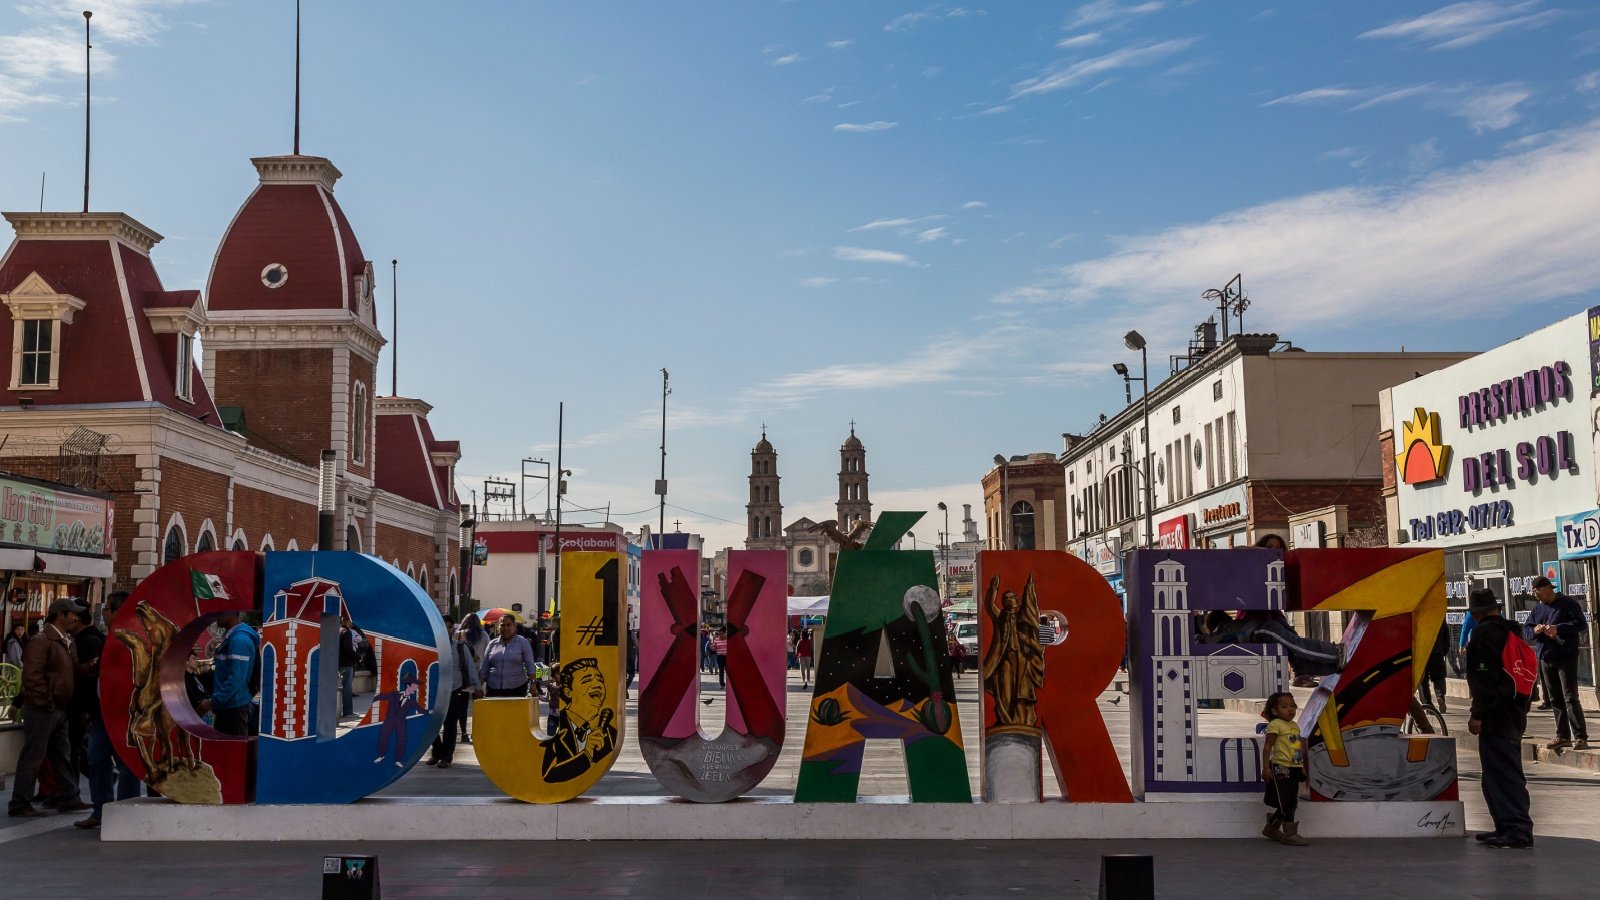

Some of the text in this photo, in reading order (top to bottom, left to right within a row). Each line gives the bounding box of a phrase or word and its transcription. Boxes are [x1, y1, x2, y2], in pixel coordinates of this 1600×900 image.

[1459, 361, 1567, 428] PRESTAMOS
[1462, 430, 1569, 492] DEL SOL
[2, 486, 26, 522] Hao
[28, 491, 53, 531] City
[1410, 500, 1511, 541] Tel 612-0772
[559, 537, 616, 548] Scotiabank
[1175, 524, 1184, 550] K
